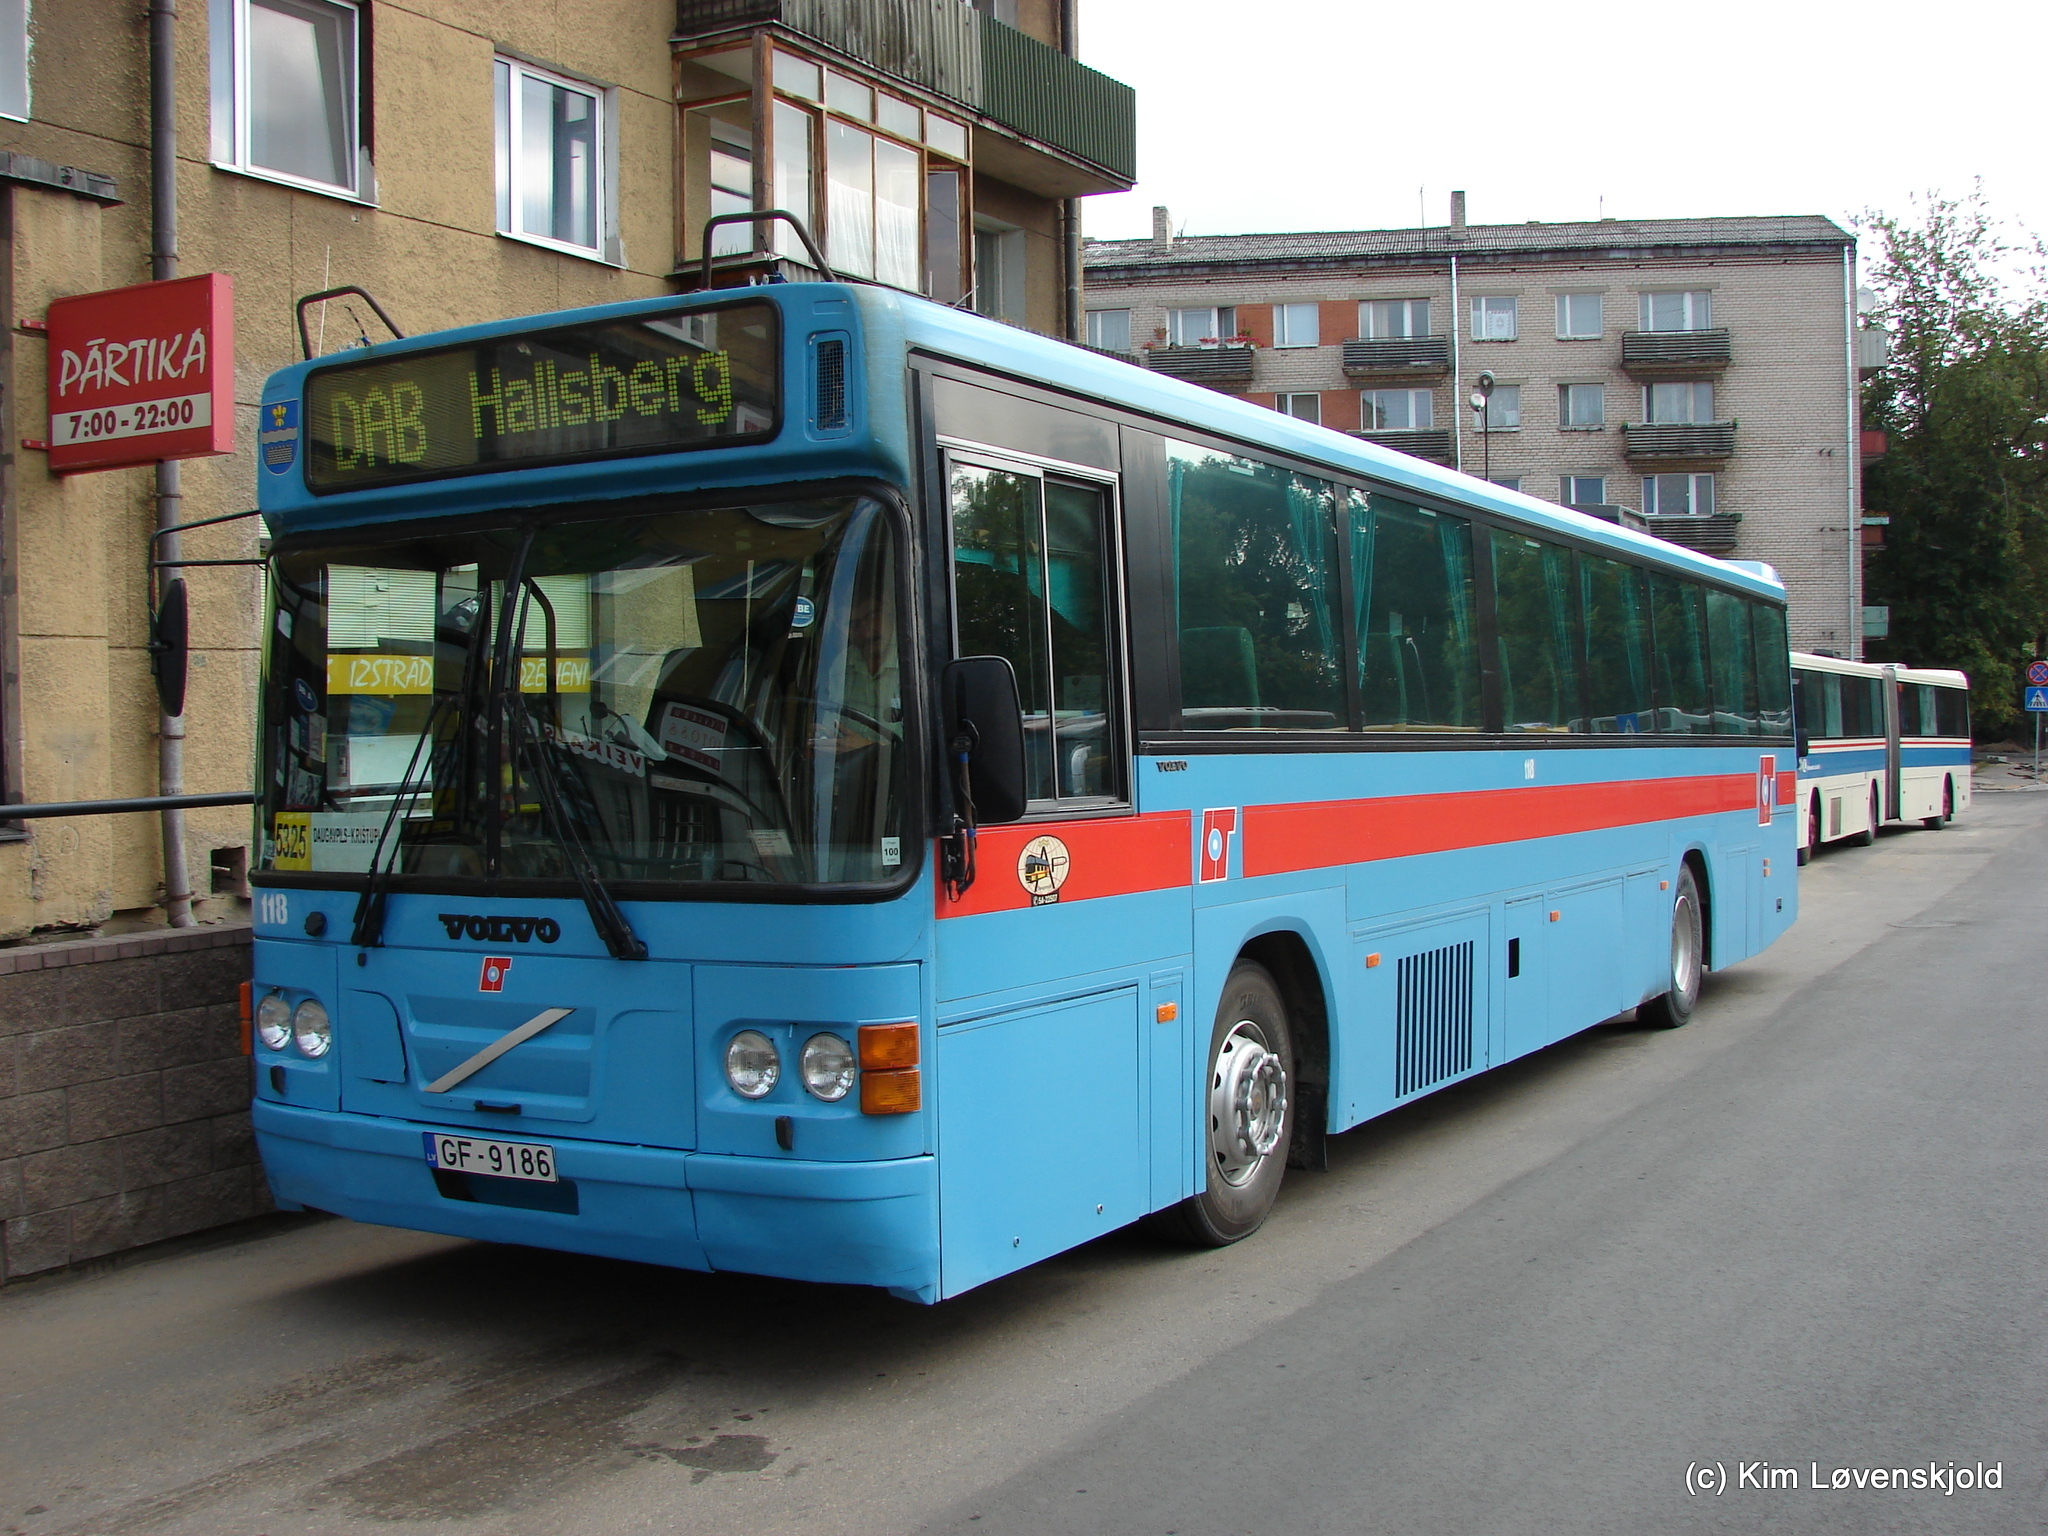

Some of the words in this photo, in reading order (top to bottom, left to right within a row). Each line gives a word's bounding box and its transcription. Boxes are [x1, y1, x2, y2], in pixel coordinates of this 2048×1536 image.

[59, 327, 207, 397] PĀRTIKA
[69, 410, 117, 439] 7:00
[134, 399, 194, 430] 22:00
[331, 381, 428, 471] DAB
[470, 350, 732, 438] Hallsberg
[1155, 760, 1188, 773] VOLVO
[1524, 759, 1535, 779] 118
[276, 823, 307, 859] 5325
[884, 847, 898, 856] 100
[260, 893, 288, 925] 118
[438, 913, 561, 944] VOLVO
[426, 1153, 437, 1162] LV
[441, 1138, 551, 1178] GF-9186
